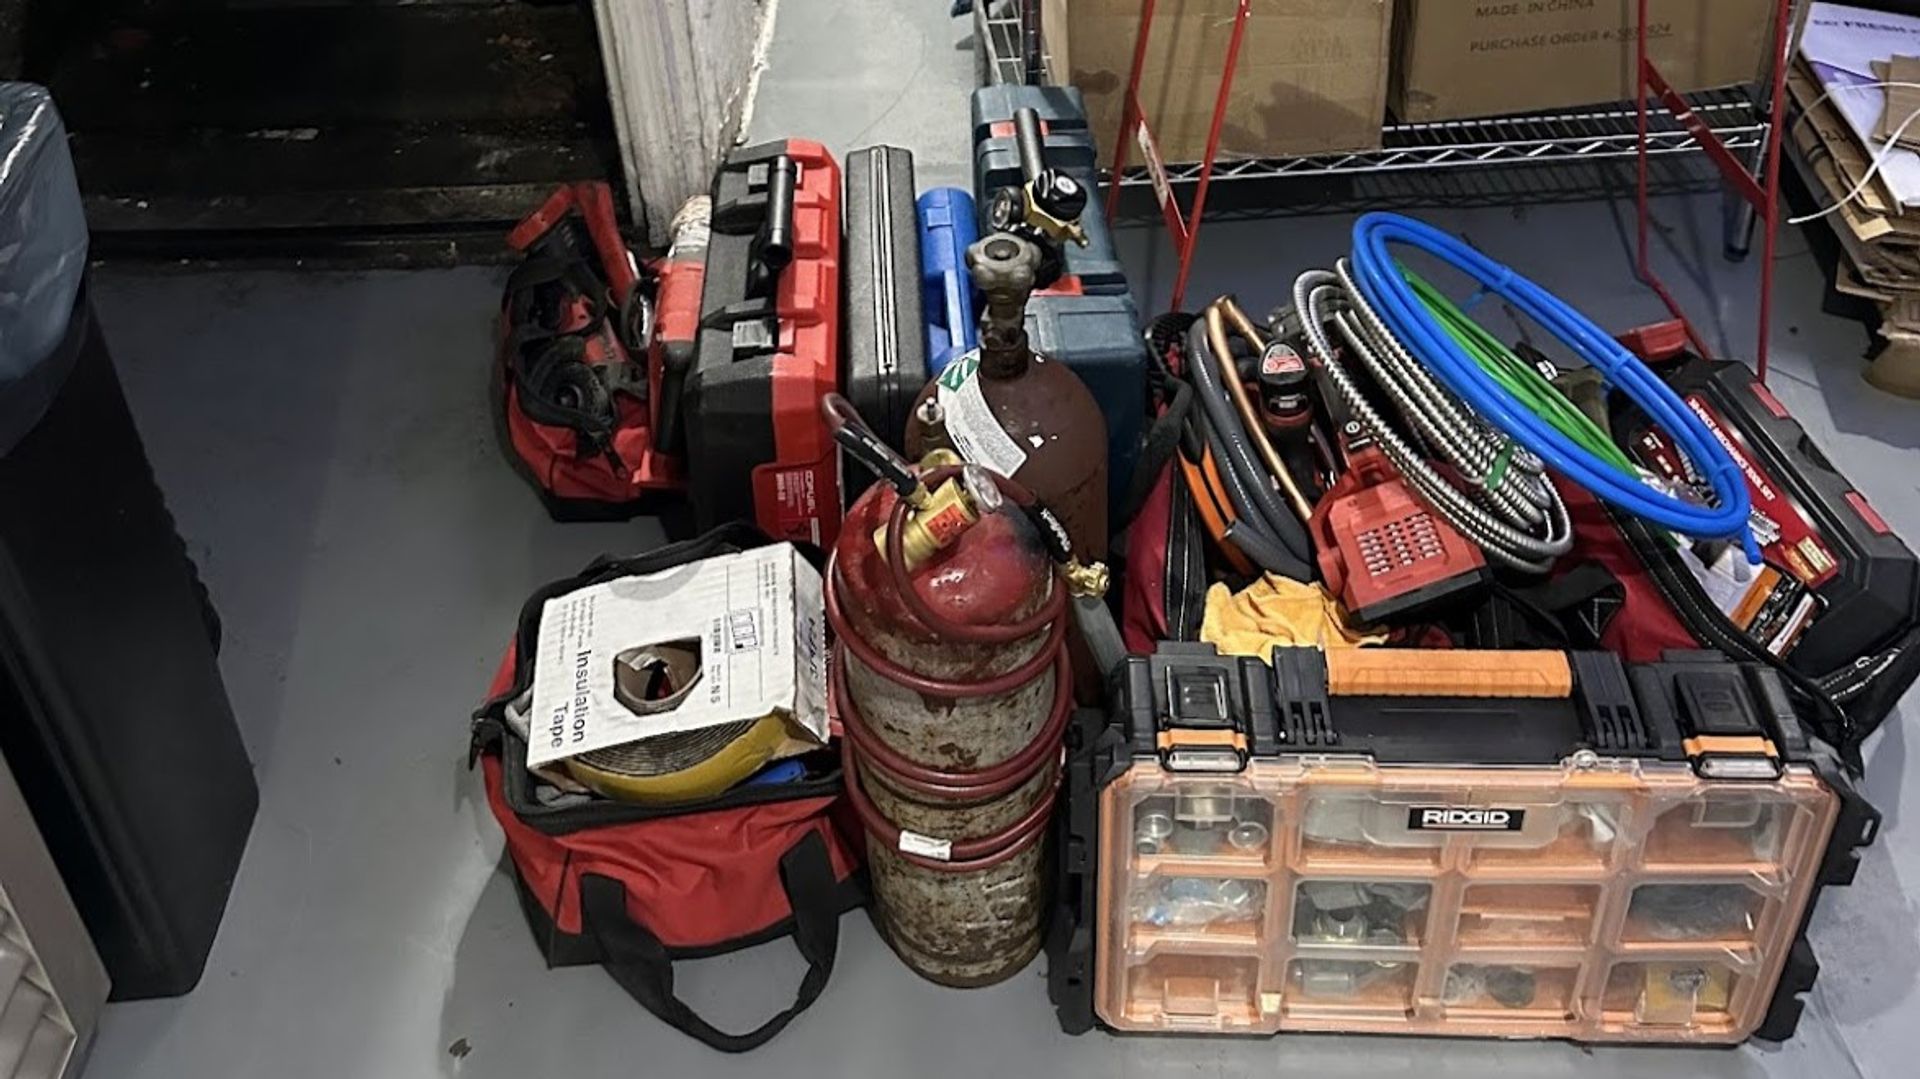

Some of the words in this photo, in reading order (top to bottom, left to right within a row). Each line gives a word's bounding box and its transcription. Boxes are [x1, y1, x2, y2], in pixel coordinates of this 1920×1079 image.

[1475, 4, 1519, 17] MADE
[1527, 2, 1544, 14] IN
[1547, 0, 1594, 12] CHINA
[1470, 34, 1546, 52] PURCHASE
[1550, 30, 1598, 45] ORDER
[1745, 465, 1764, 492] TOOL
[1760, 483, 1776, 502] SET
[573, 648, 593, 744] Insulation
[550, 702, 570, 749] Tape
[1422, 809, 1511, 824] RIDGID
